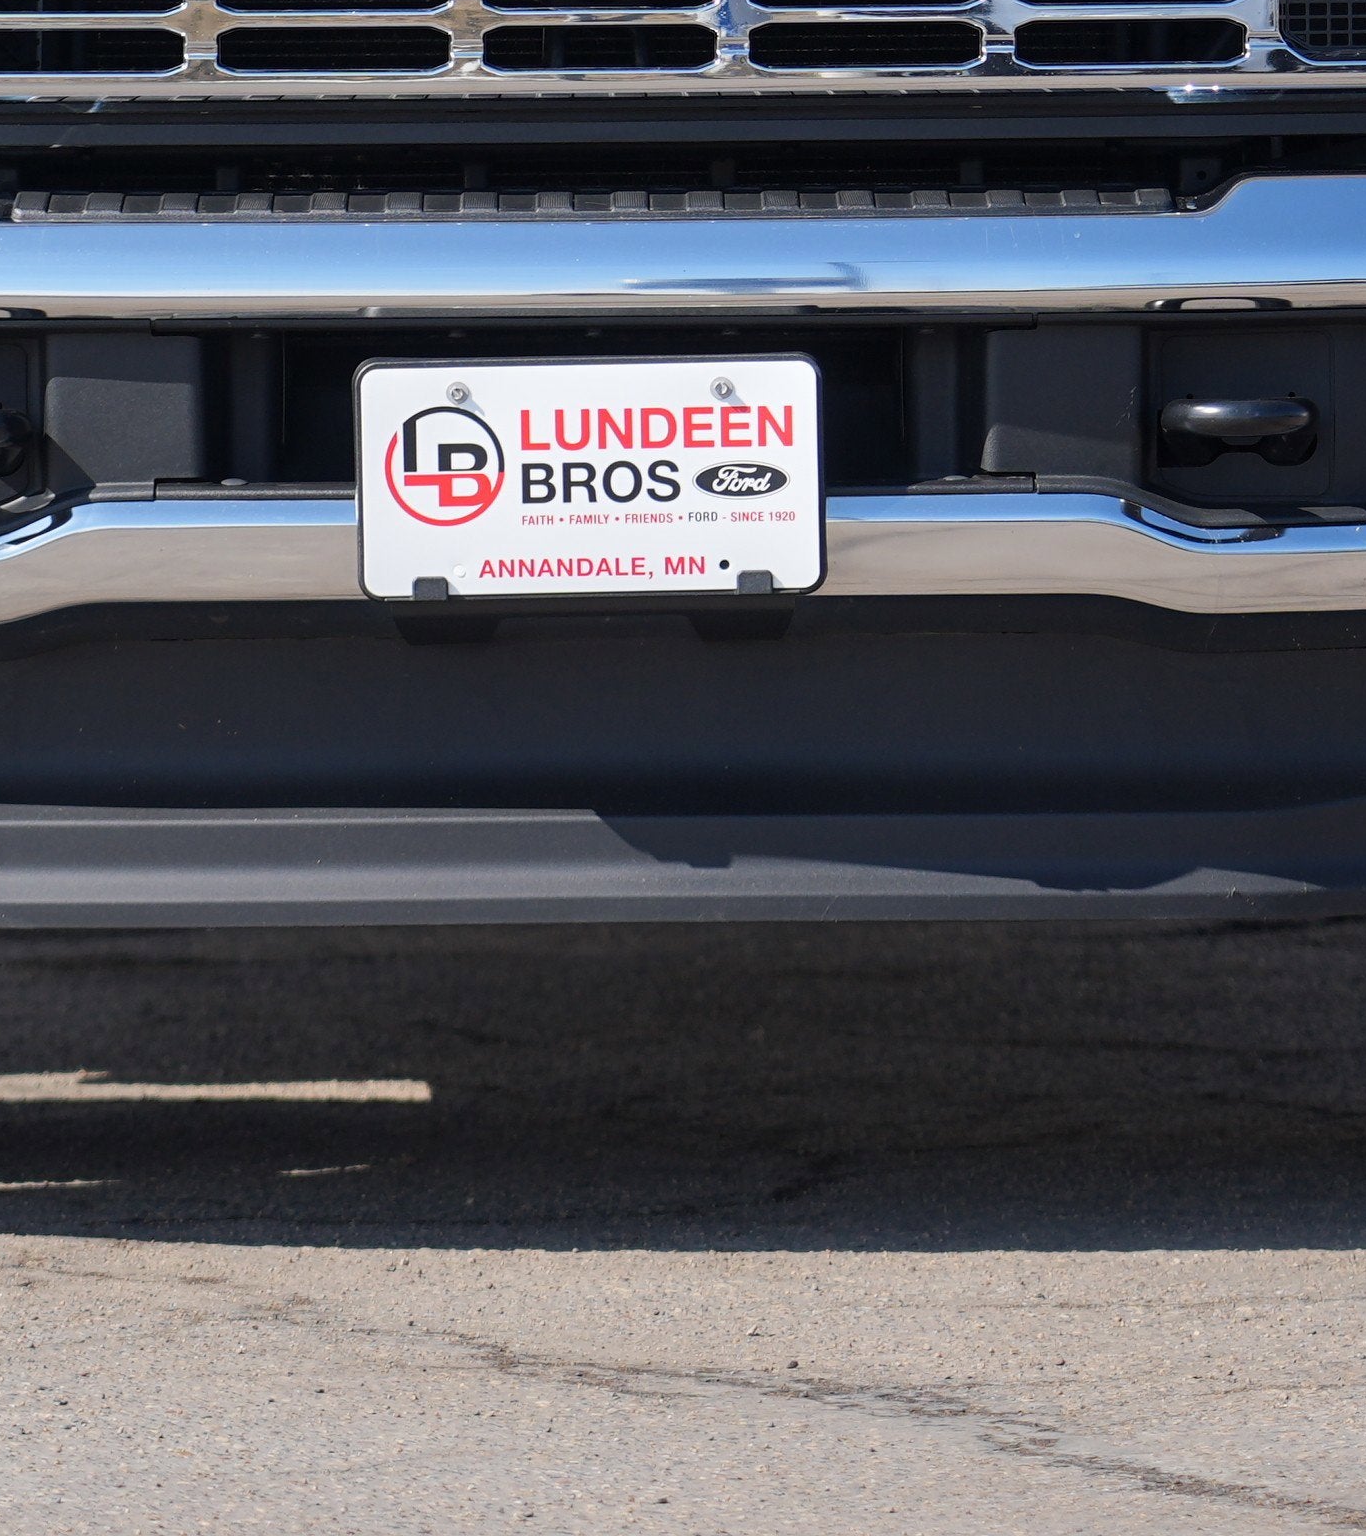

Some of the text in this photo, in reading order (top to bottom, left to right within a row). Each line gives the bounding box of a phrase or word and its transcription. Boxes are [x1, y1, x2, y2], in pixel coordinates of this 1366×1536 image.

[520, 405, 793, 451] LUNDEEN
[521, 459, 682, 505] BROS
[712, 465, 772, 492] Ford
[521, 510, 796, 526] FAITH FAMILY FRIENDS FORD SINCE 1920
[478, 556, 706, 580] ANNANDALE, MN
